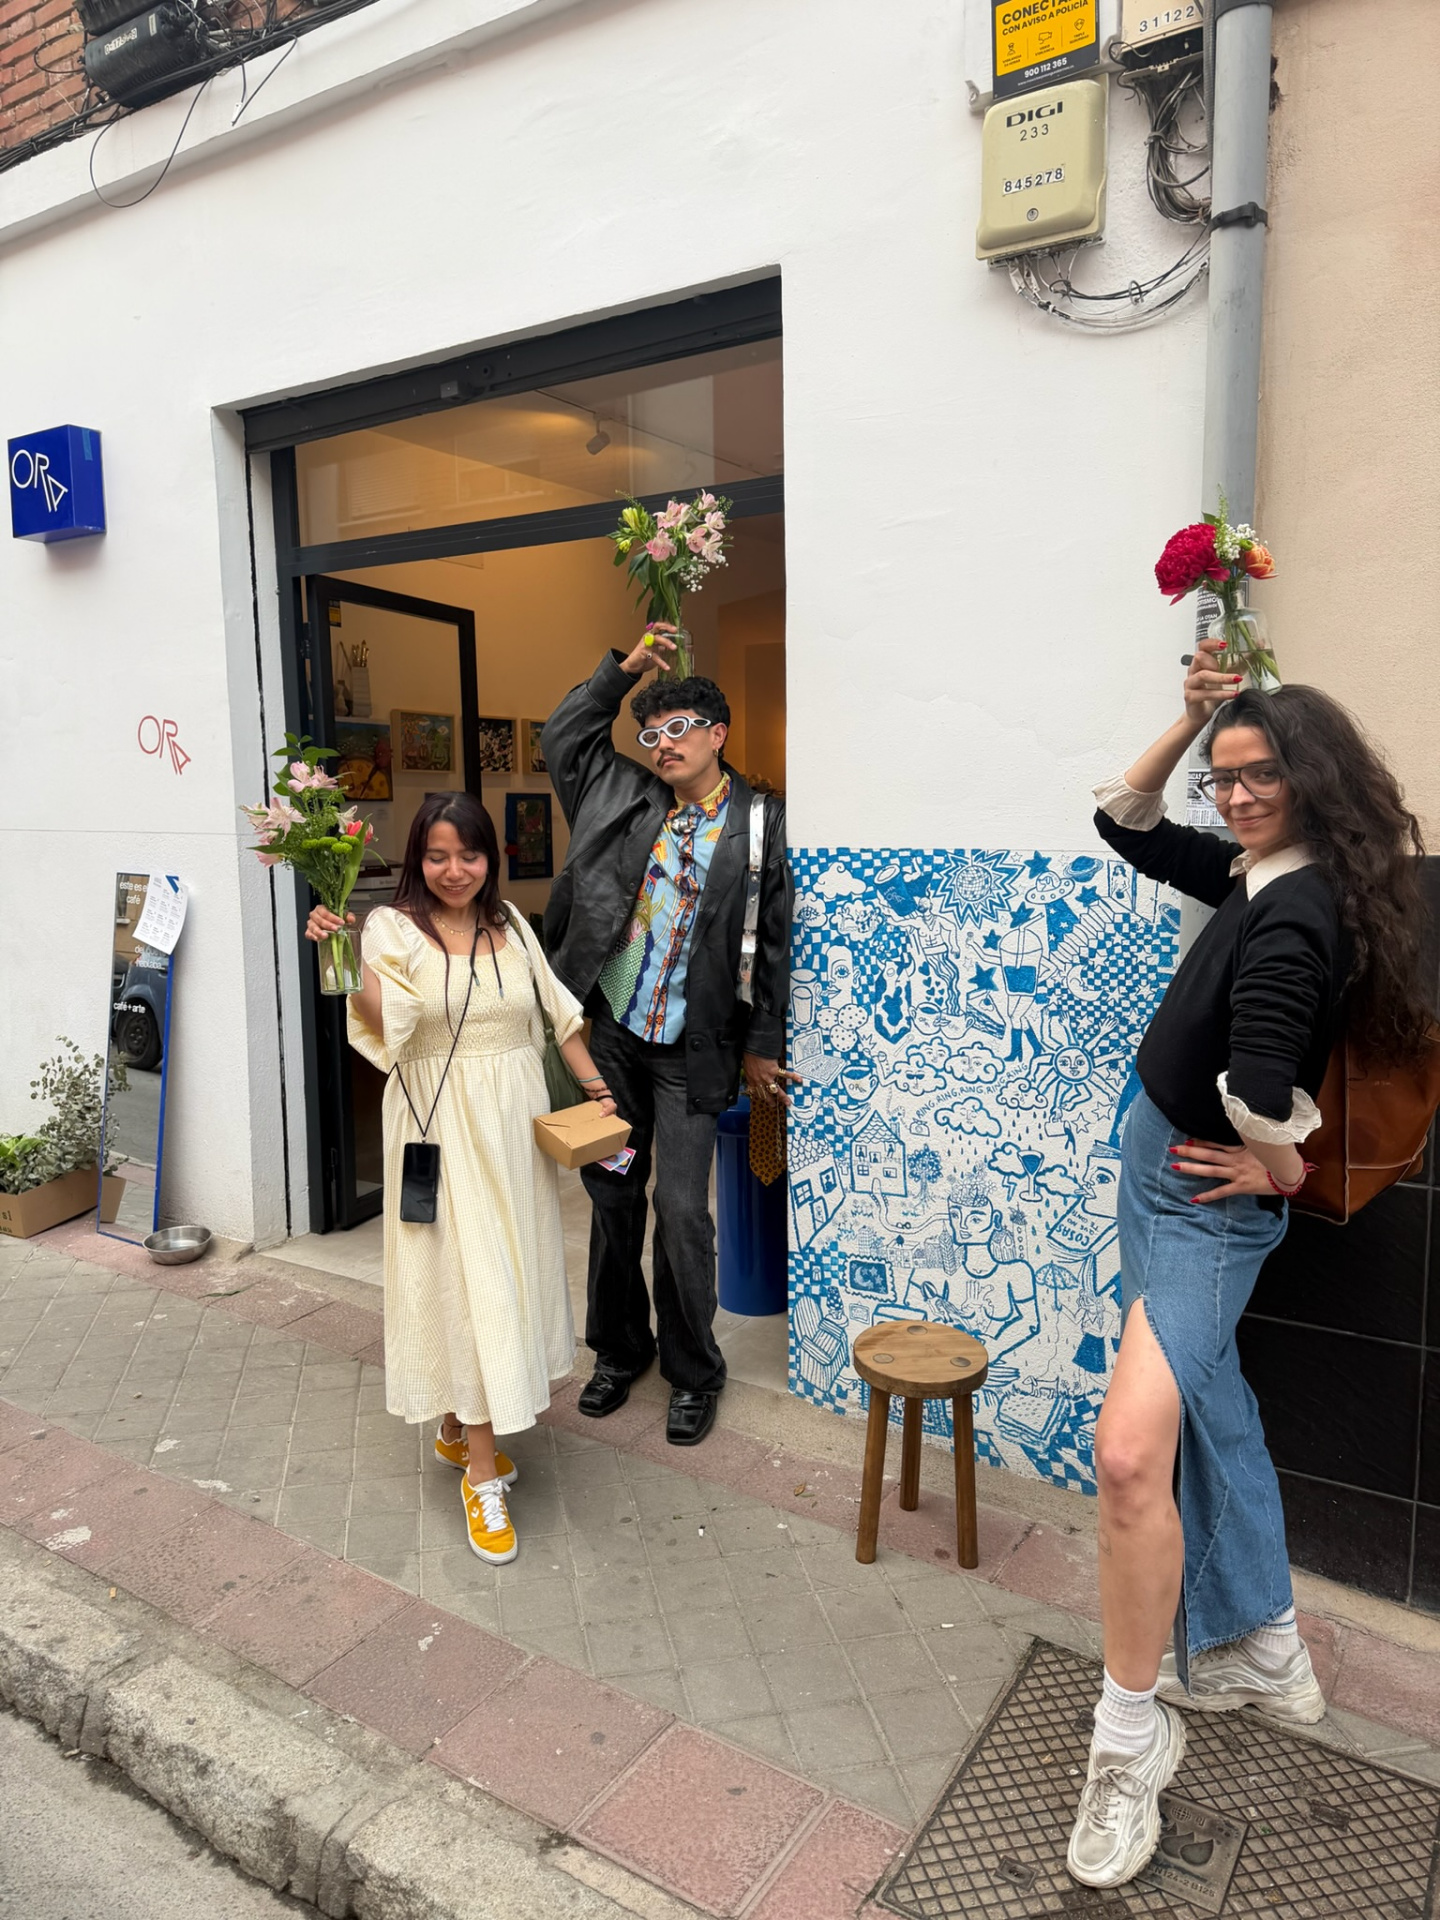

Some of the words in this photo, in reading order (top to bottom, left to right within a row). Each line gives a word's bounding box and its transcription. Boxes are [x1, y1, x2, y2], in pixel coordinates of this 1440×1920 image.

[1002, 23, 1020, 36] CON
[1022, 14, 1047, 29] AVISO
[1049, 11, 1055, 20] A
[1140, 6, 1194, 32] 31122
[1024, 68, 1039, 78] 900
[1041, 62, 1051, 73] 112
[1052, 57, 1067, 69] 365
[1006, 101, 1063, 128] DIGI
[1020, 123, 1049, 141] 233
[1004, 168, 1063, 193] 845278
[11, 449, 69, 513] ORA
[137, 715, 191, 775] ORA
[120, 881, 133, 890] este
[134, 883, 143, 892] es
[126, 894, 141, 905] café
[1056, 1224, 1090, 1247] COSAS
